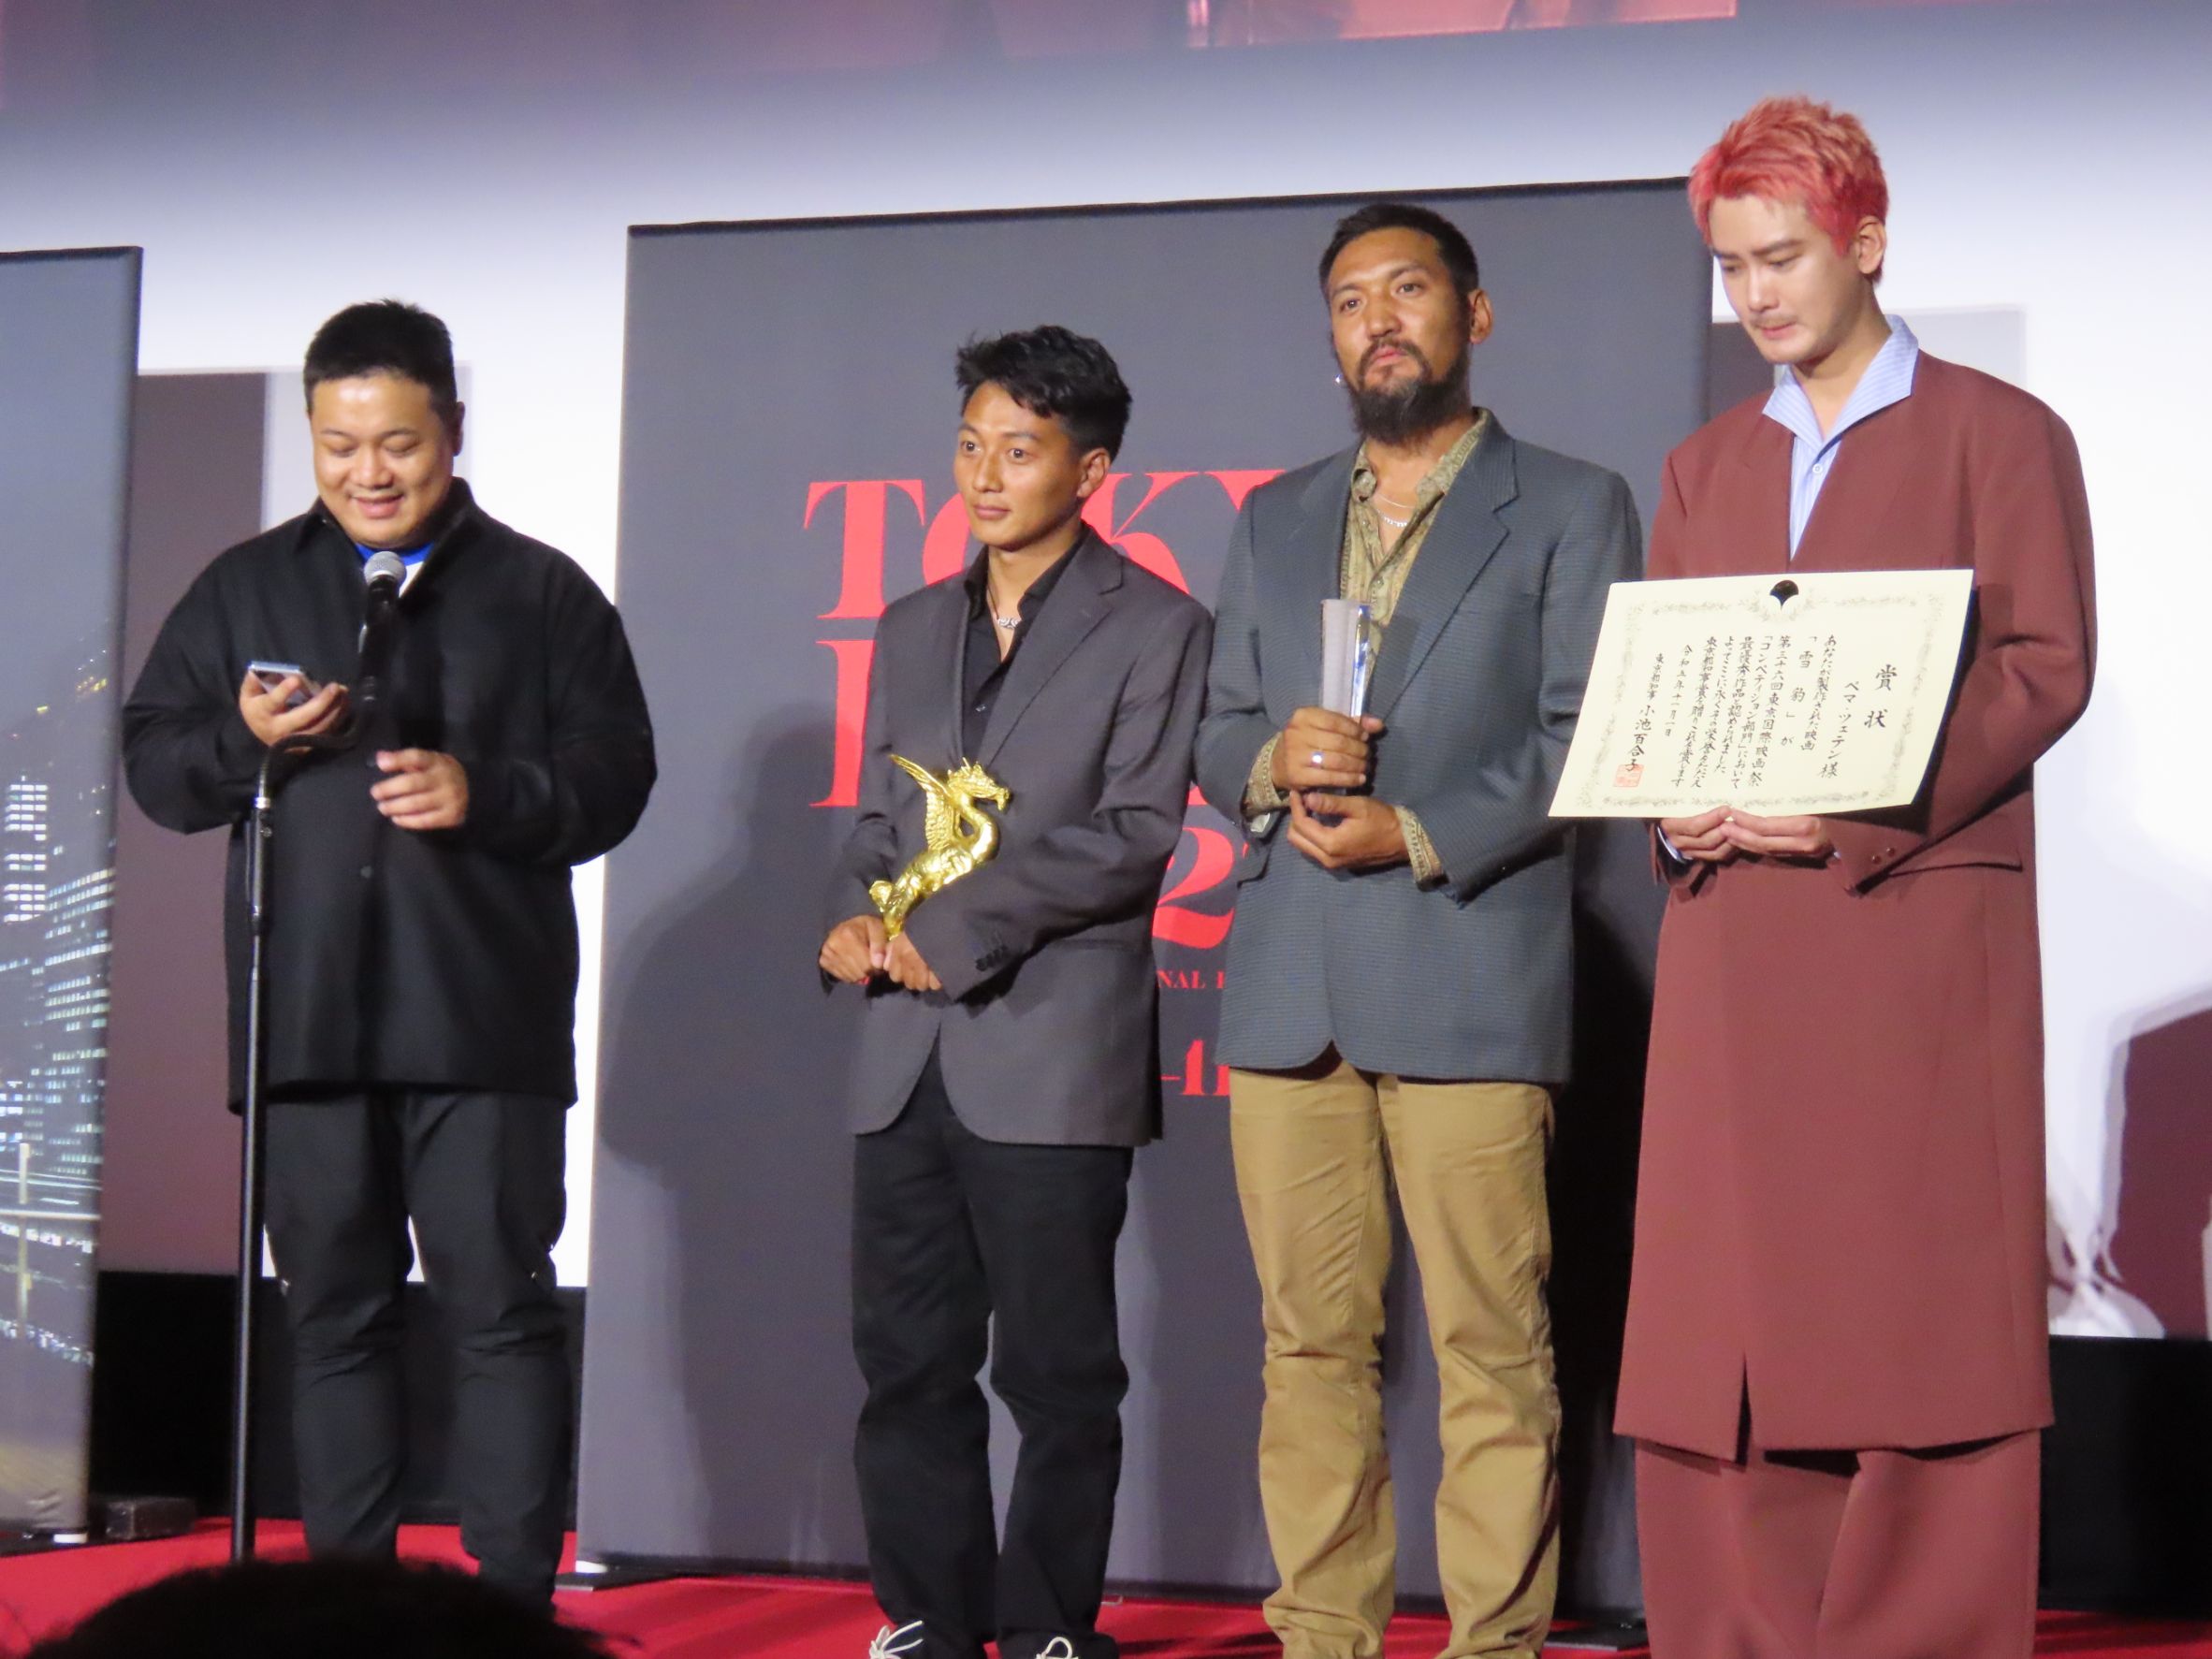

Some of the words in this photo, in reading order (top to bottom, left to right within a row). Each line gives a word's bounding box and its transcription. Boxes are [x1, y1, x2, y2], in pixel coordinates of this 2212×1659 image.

[1665, 644, 1693, 736] 令和五年十一月一日
[1748, 634, 1791, 787] 第三十六回東京国際映画祭
[1800, 634, 1837, 750] あなたが製作された映画
[1818, 680, 1859, 779] ペマ・ツェテン様
[1864, 663, 1898, 729] 賞状
[1624, 705, 1655, 772] 小池百合子
